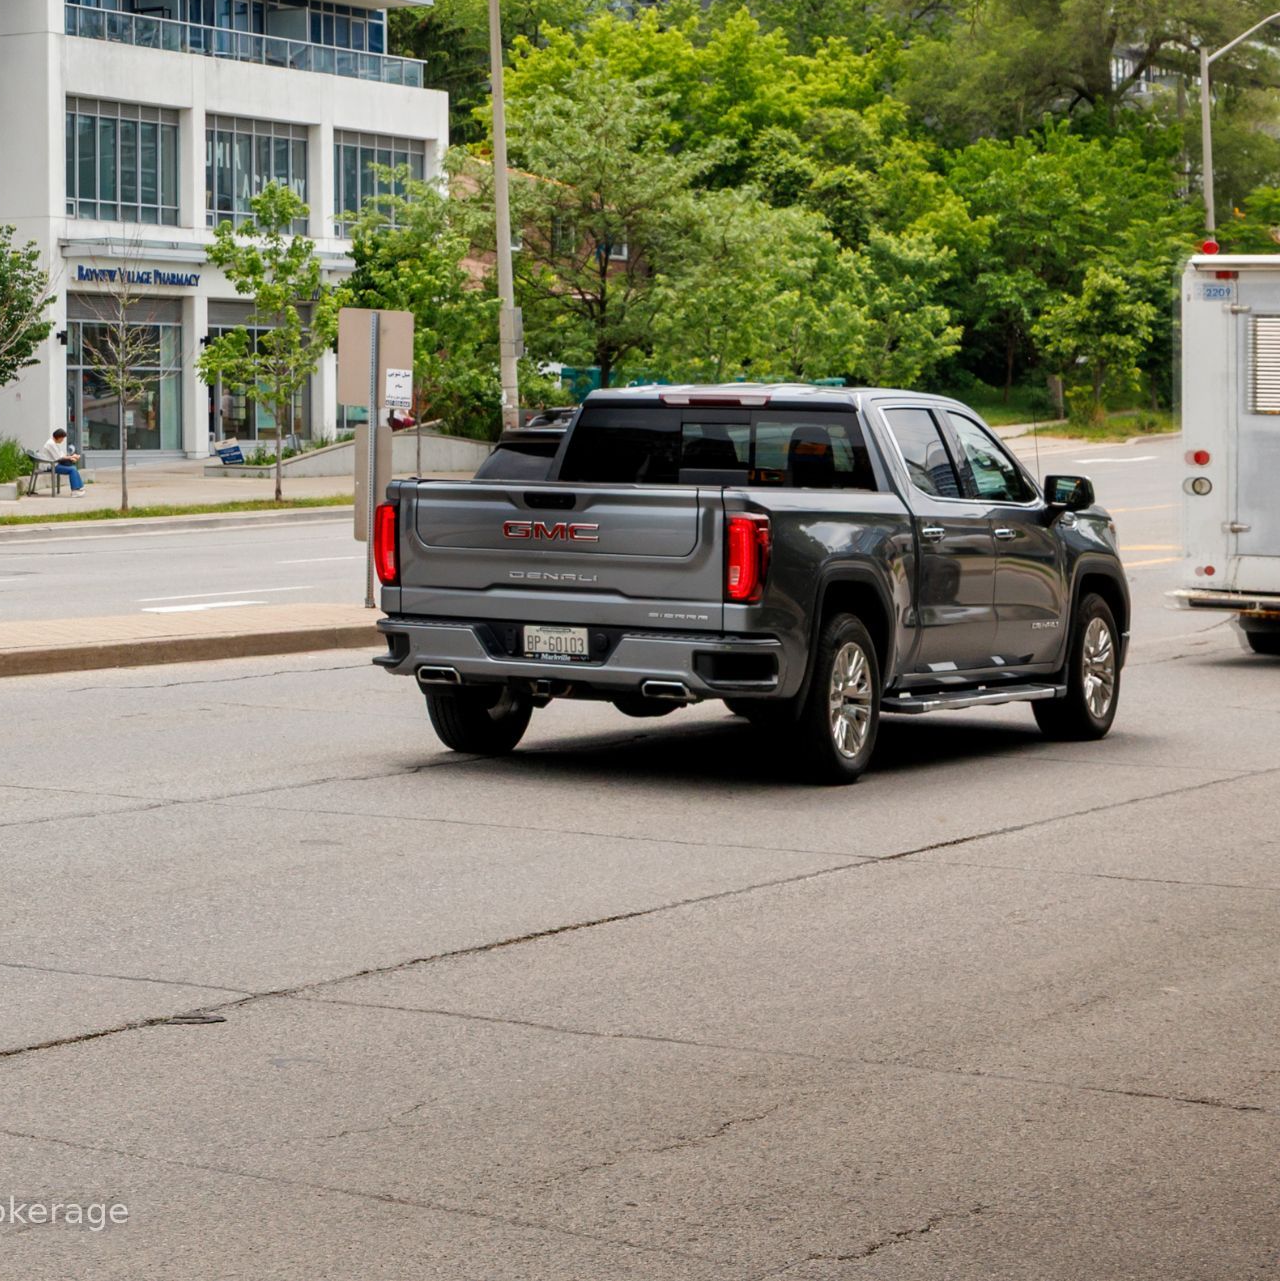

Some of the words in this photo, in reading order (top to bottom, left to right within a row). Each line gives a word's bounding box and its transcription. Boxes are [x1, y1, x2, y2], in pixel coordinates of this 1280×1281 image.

[153, 269, 200, 287] PHARMACY
[1206, 287, 1231, 297] 2209
[502, 520, 599, 543] GMC
[509, 570, 598, 582] DENALI
[648, 612, 708, 621] SIERRA
